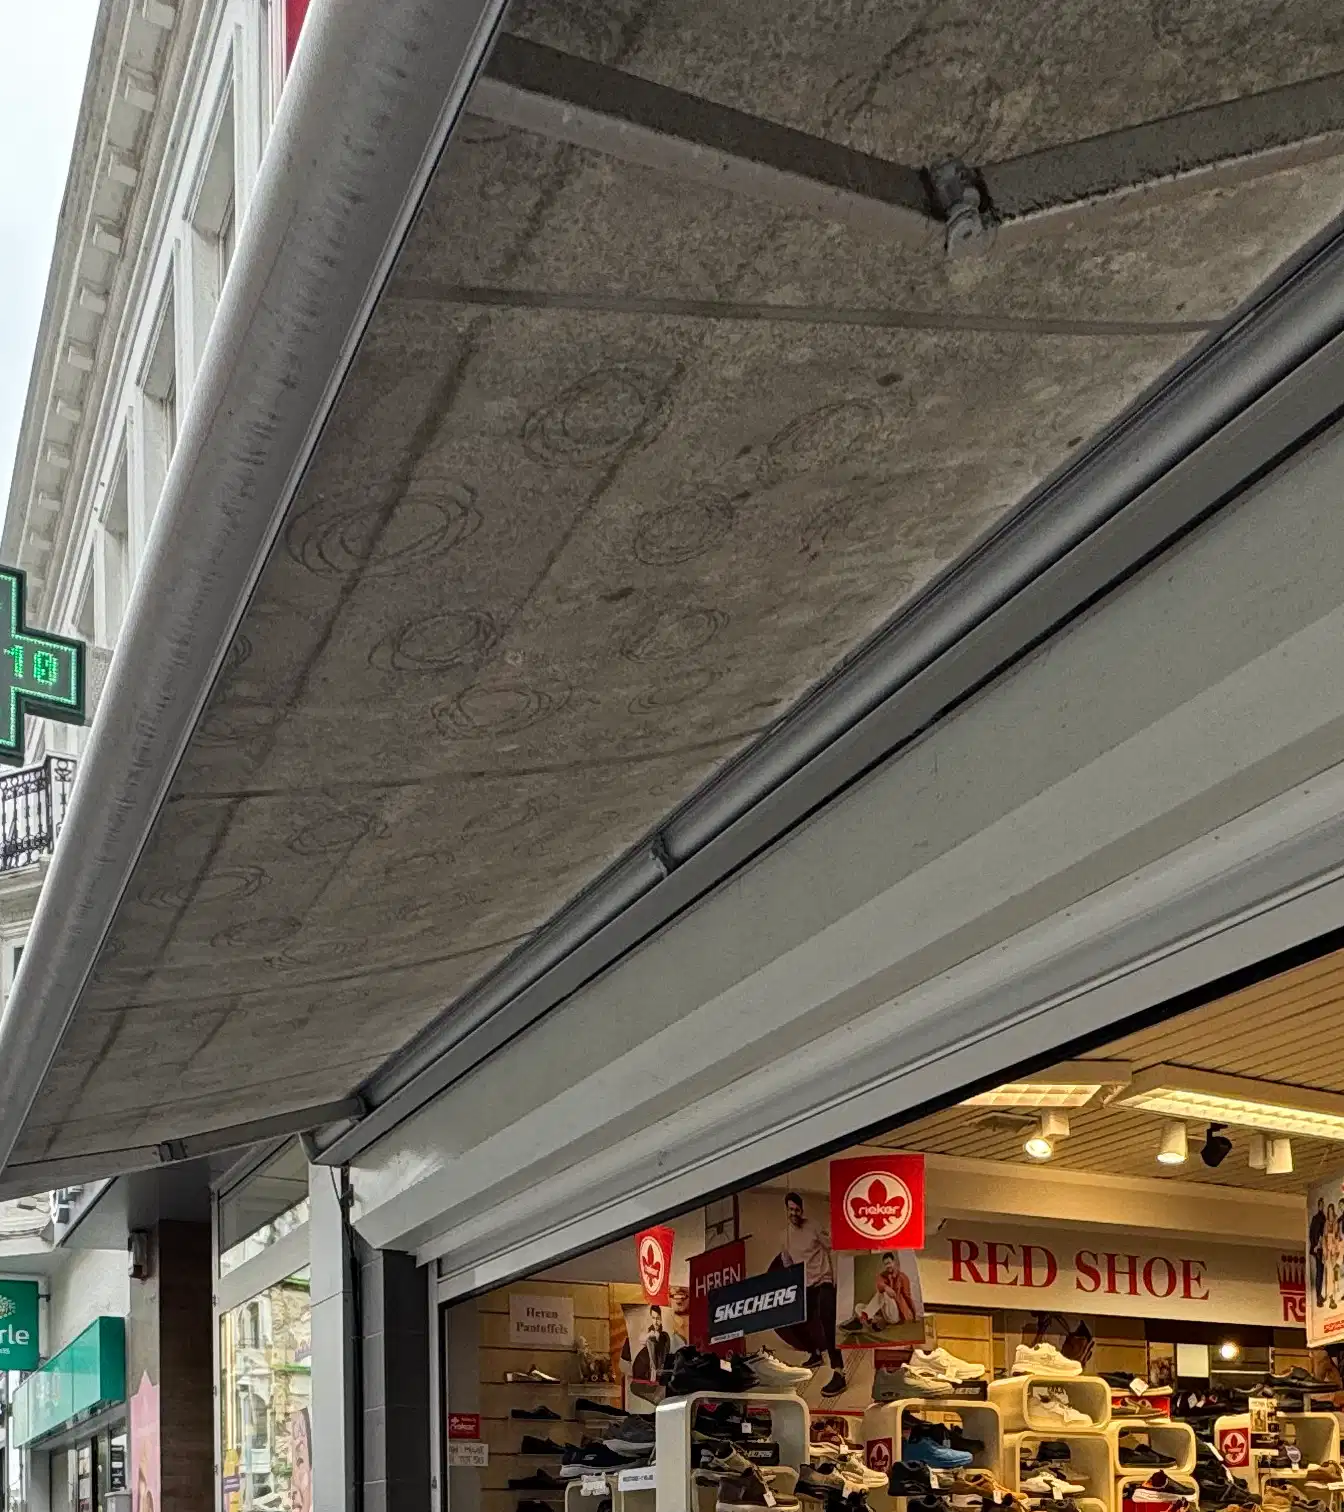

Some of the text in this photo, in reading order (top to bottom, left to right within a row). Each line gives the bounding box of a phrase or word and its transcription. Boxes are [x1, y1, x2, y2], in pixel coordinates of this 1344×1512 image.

[857, 1202, 901, 1218] rieker
[947, 1238, 1211, 1301] RED SHOE
[713, 1285, 798, 1324] SKECHERS
